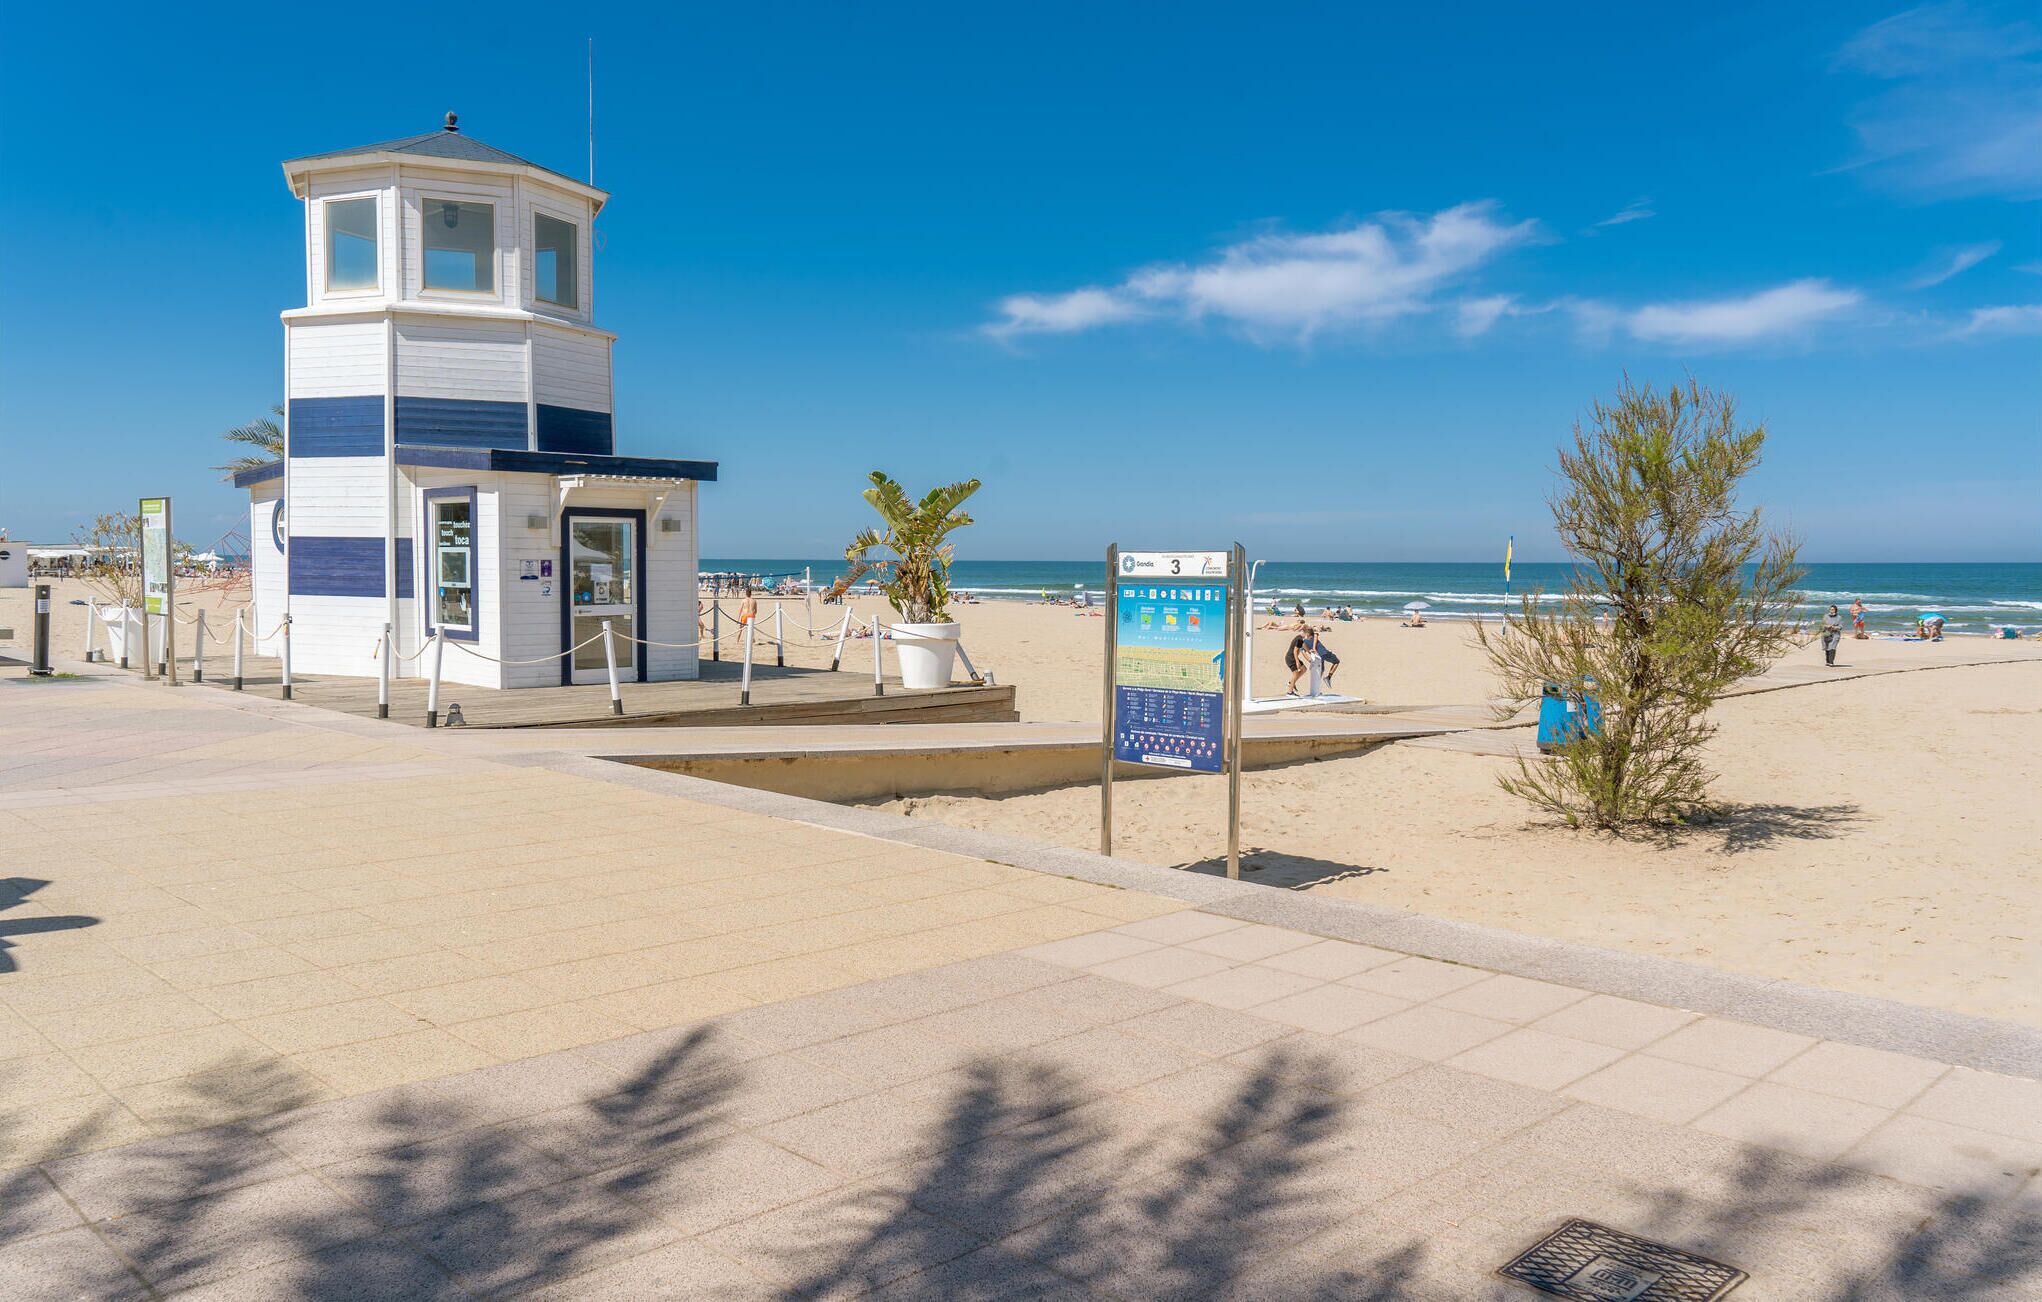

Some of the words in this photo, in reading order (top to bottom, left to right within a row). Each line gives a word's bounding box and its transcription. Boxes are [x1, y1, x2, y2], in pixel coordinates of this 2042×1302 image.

[441, 528, 454, 536] touch
[455, 534, 469, 544] toca
[1170, 559, 1181, 575] 3
